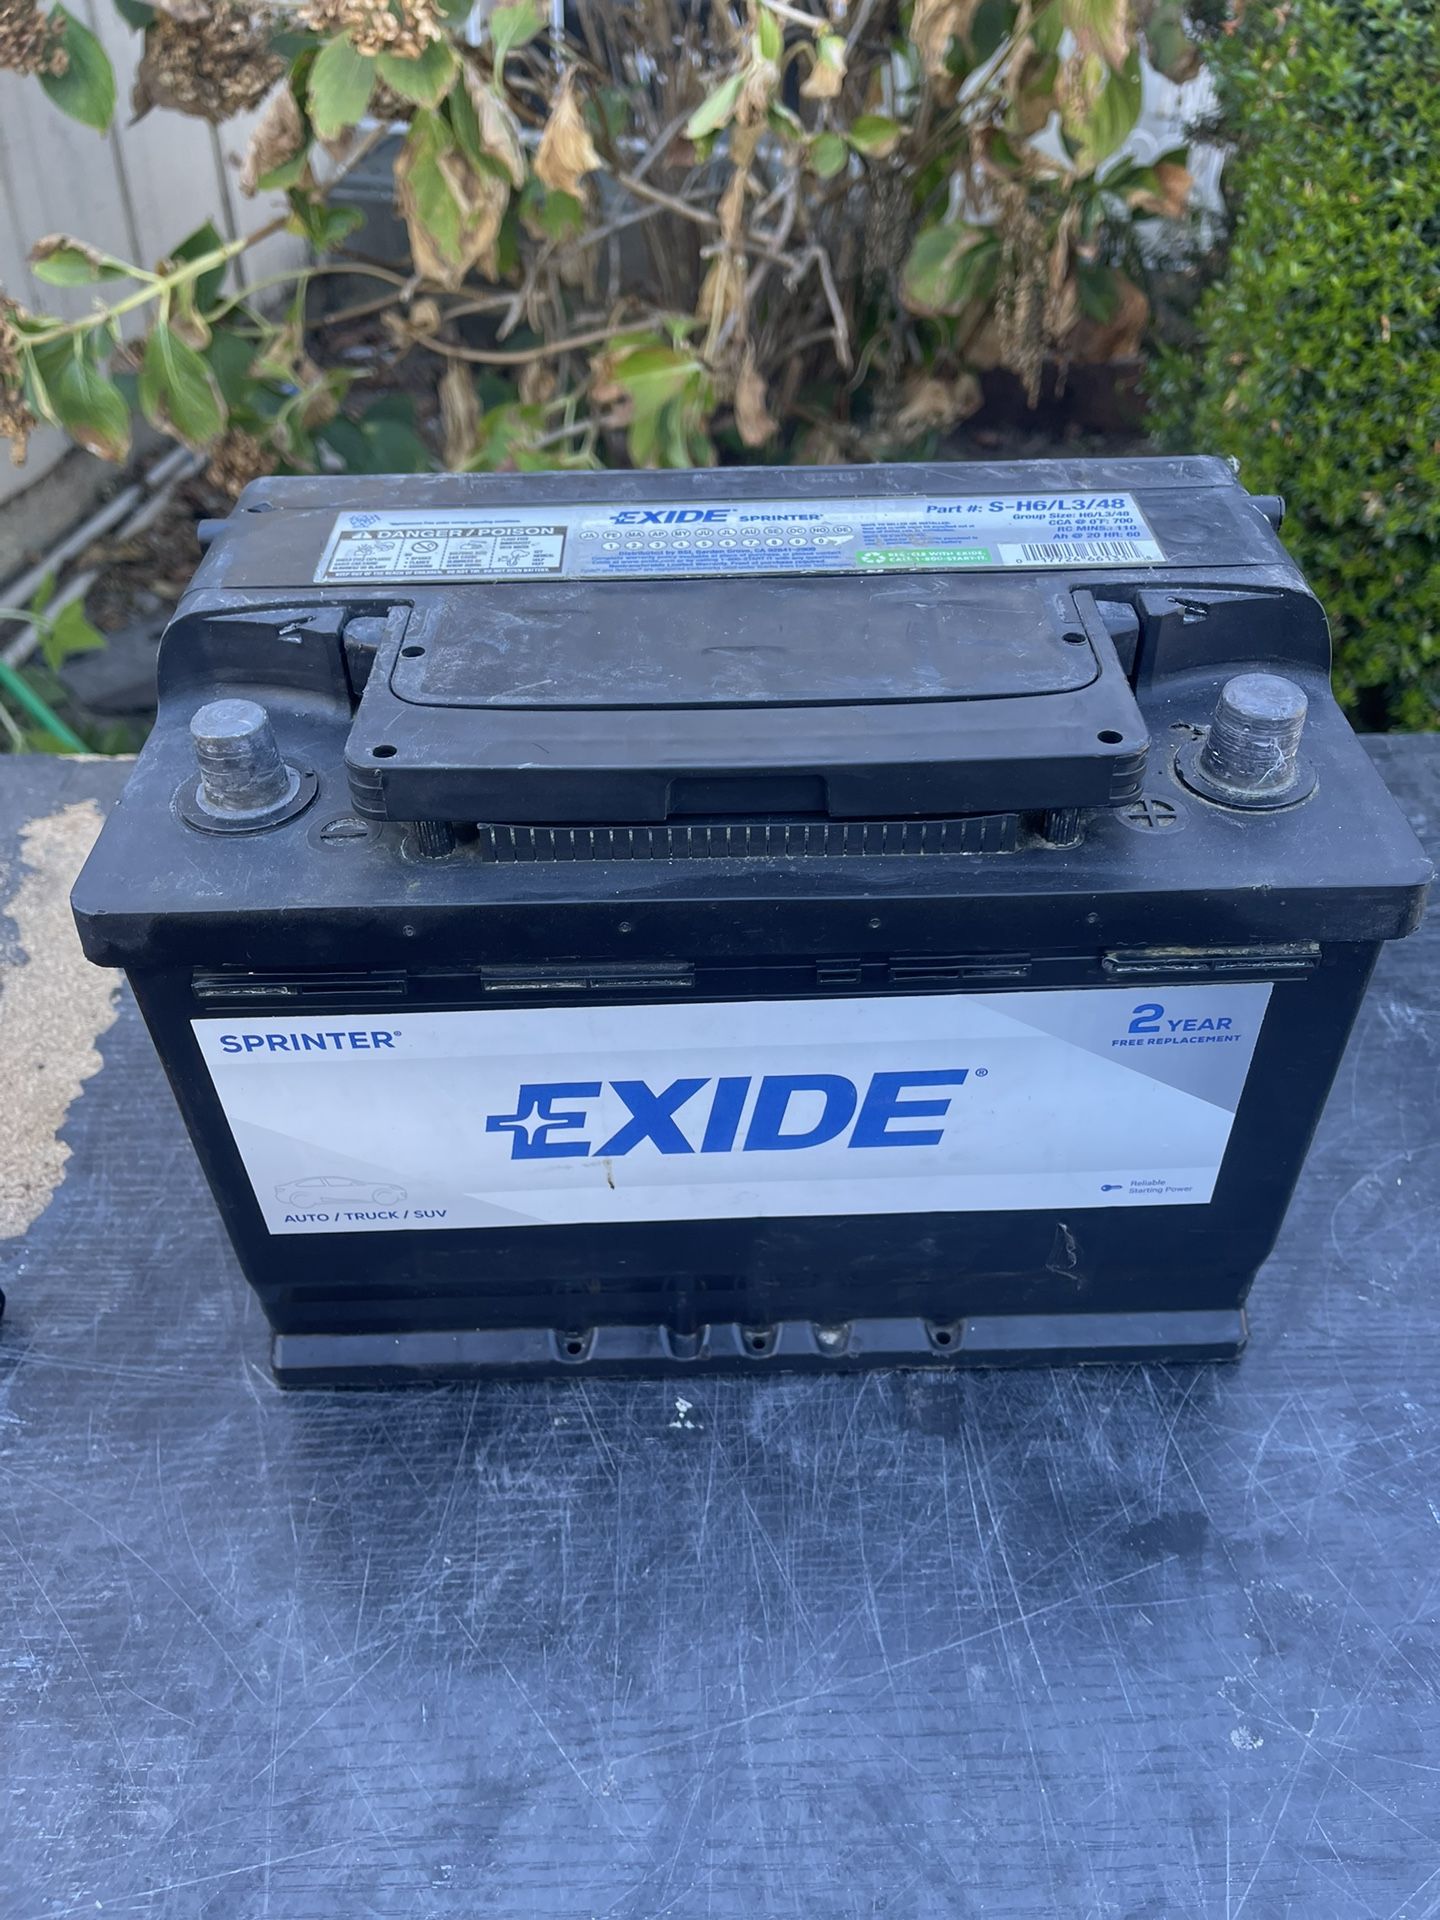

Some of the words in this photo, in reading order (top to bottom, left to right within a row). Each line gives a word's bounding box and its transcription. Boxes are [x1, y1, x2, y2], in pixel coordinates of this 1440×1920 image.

[927, 504, 961, 514] Part
[968, 504, 982, 512] #:
[988, 498, 1126, 512] S-H6/L3/48
[1012, 513, 1046, 521] Group
[1127, 1003, 1165, 1034] 2
[1168, 1017, 1233, 1032] YEAR
[1111, 1039, 1146, 1047] FREE
[1147, 1034, 1242, 1046] REPLACEMENT
[1130, 1179, 1166, 1187] Reliable
[1128, 1186, 1163, 1195] Starting
[1165, 1185, 1193, 1193] Power
[284, 1212, 329, 1223] AUTO
[343, 1210, 399, 1221] TRUCK
[414, 1209, 448, 1219] SUV
